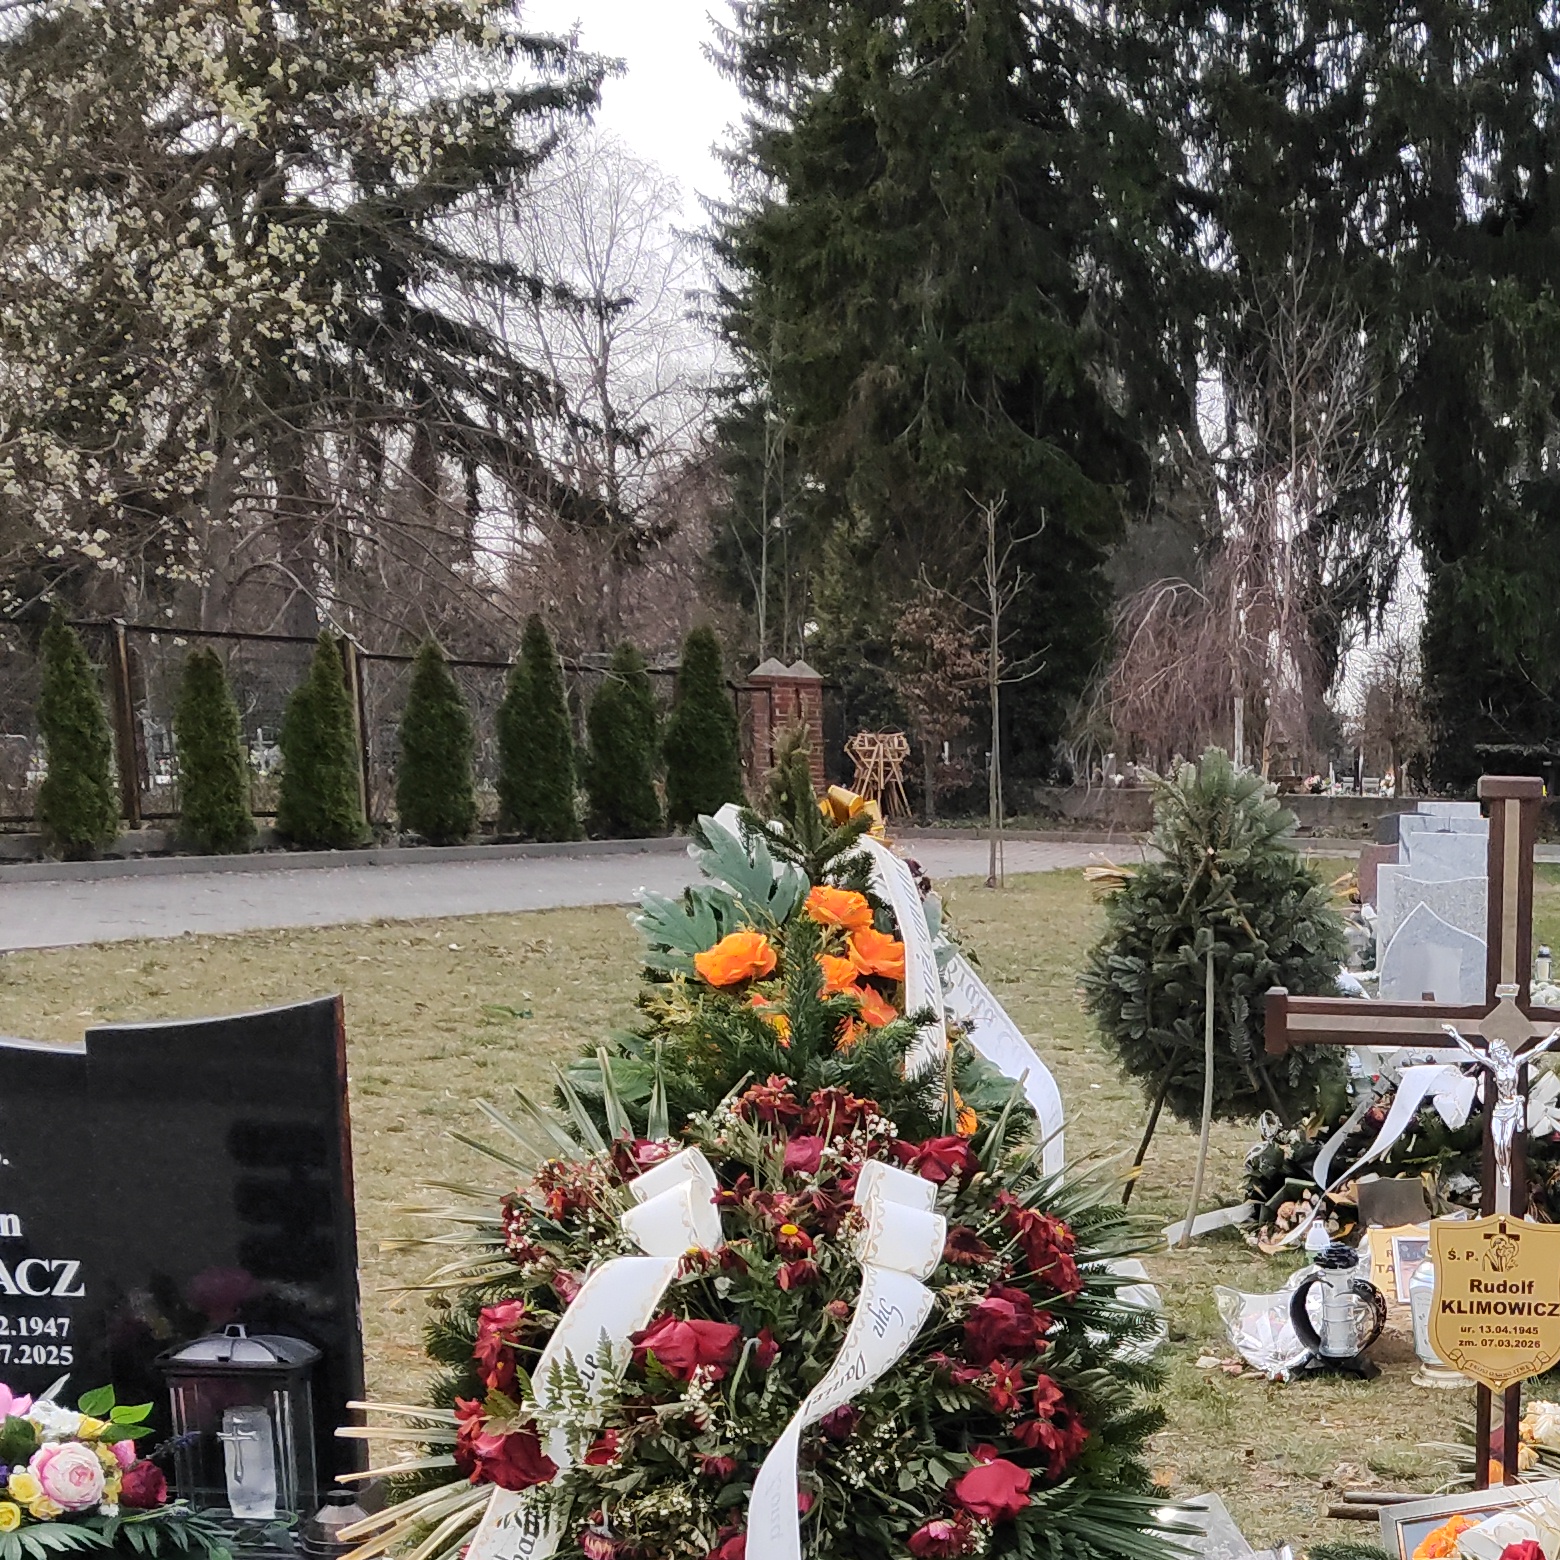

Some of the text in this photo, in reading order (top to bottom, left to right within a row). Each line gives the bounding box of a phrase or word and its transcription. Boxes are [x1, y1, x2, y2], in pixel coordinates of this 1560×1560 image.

[1469, 1278, 1535, 1295] Rudolf
[1441, 1299, 1560, 1318] KLIMOWICZ
[1460, 1326, 1475, 1334] ur.
[804, 1297, 904, 1417] Syn Daniel
